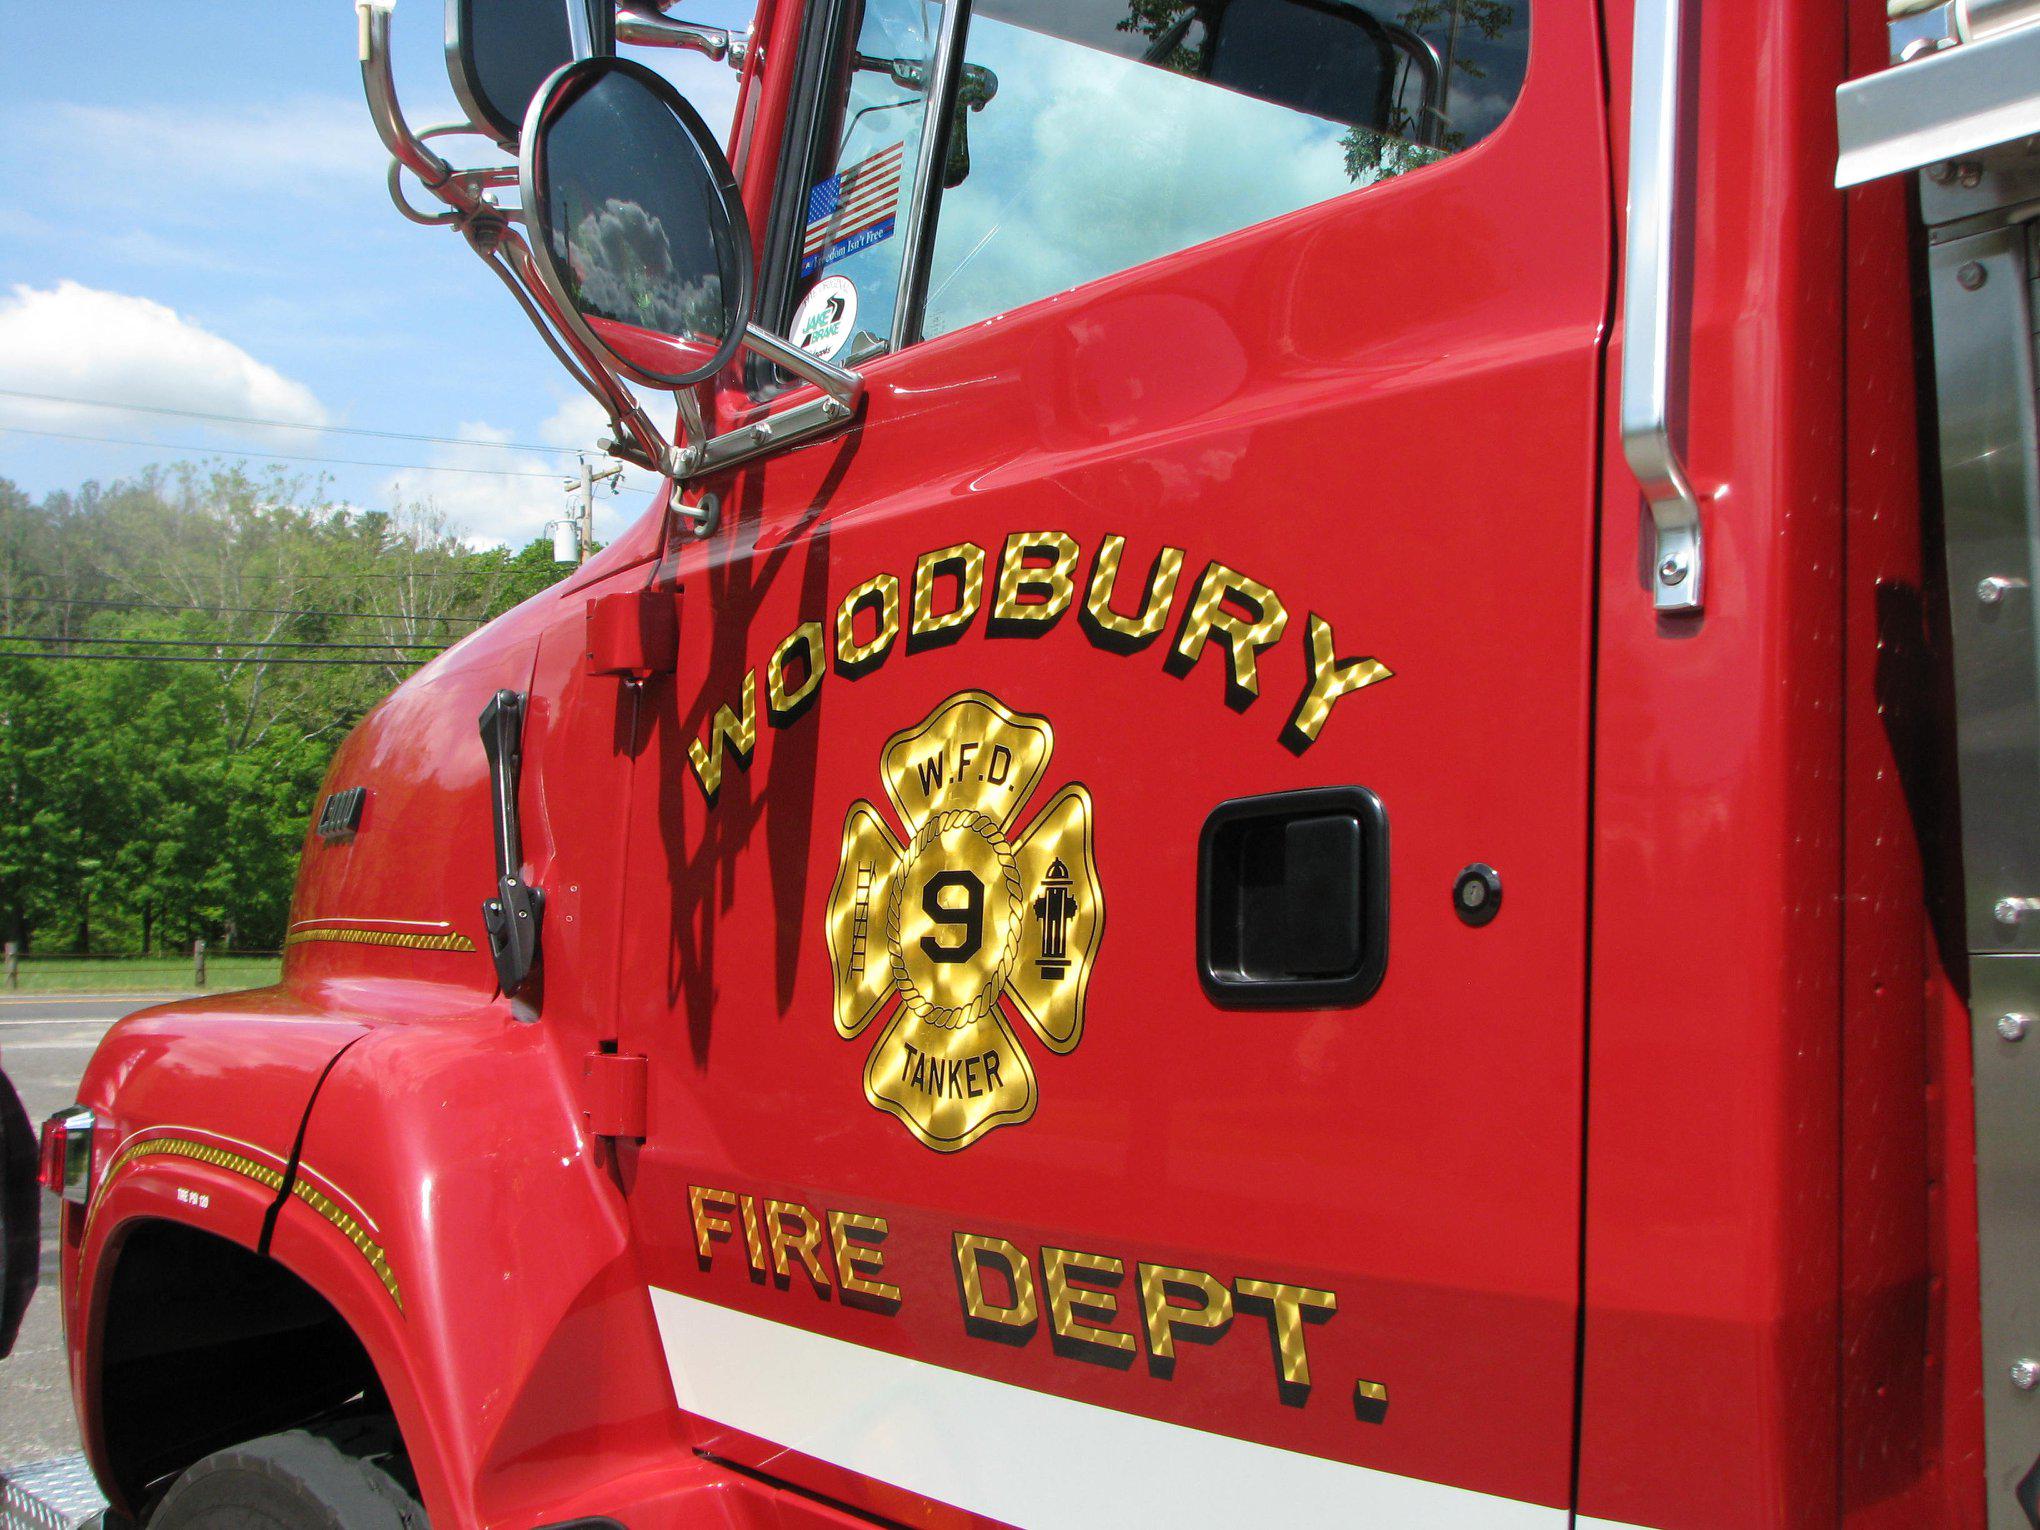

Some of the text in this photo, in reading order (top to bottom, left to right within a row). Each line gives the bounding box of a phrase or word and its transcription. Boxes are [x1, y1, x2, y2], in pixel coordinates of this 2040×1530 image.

[847, 236, 865, 252] Isn't
[866, 229, 884, 244] Free
[803, 308, 832, 333] JAKE
[811, 321, 842, 345] BRAKE
[687, 530, 1395, 756] WOODBURY
[917, 742, 1015, 798] W.F.D.
[920, 869, 985, 964] 9
[901, 1042, 1005, 1100] TANKER
[687, 1184, 1389, 1424] FIRE DEPT.
